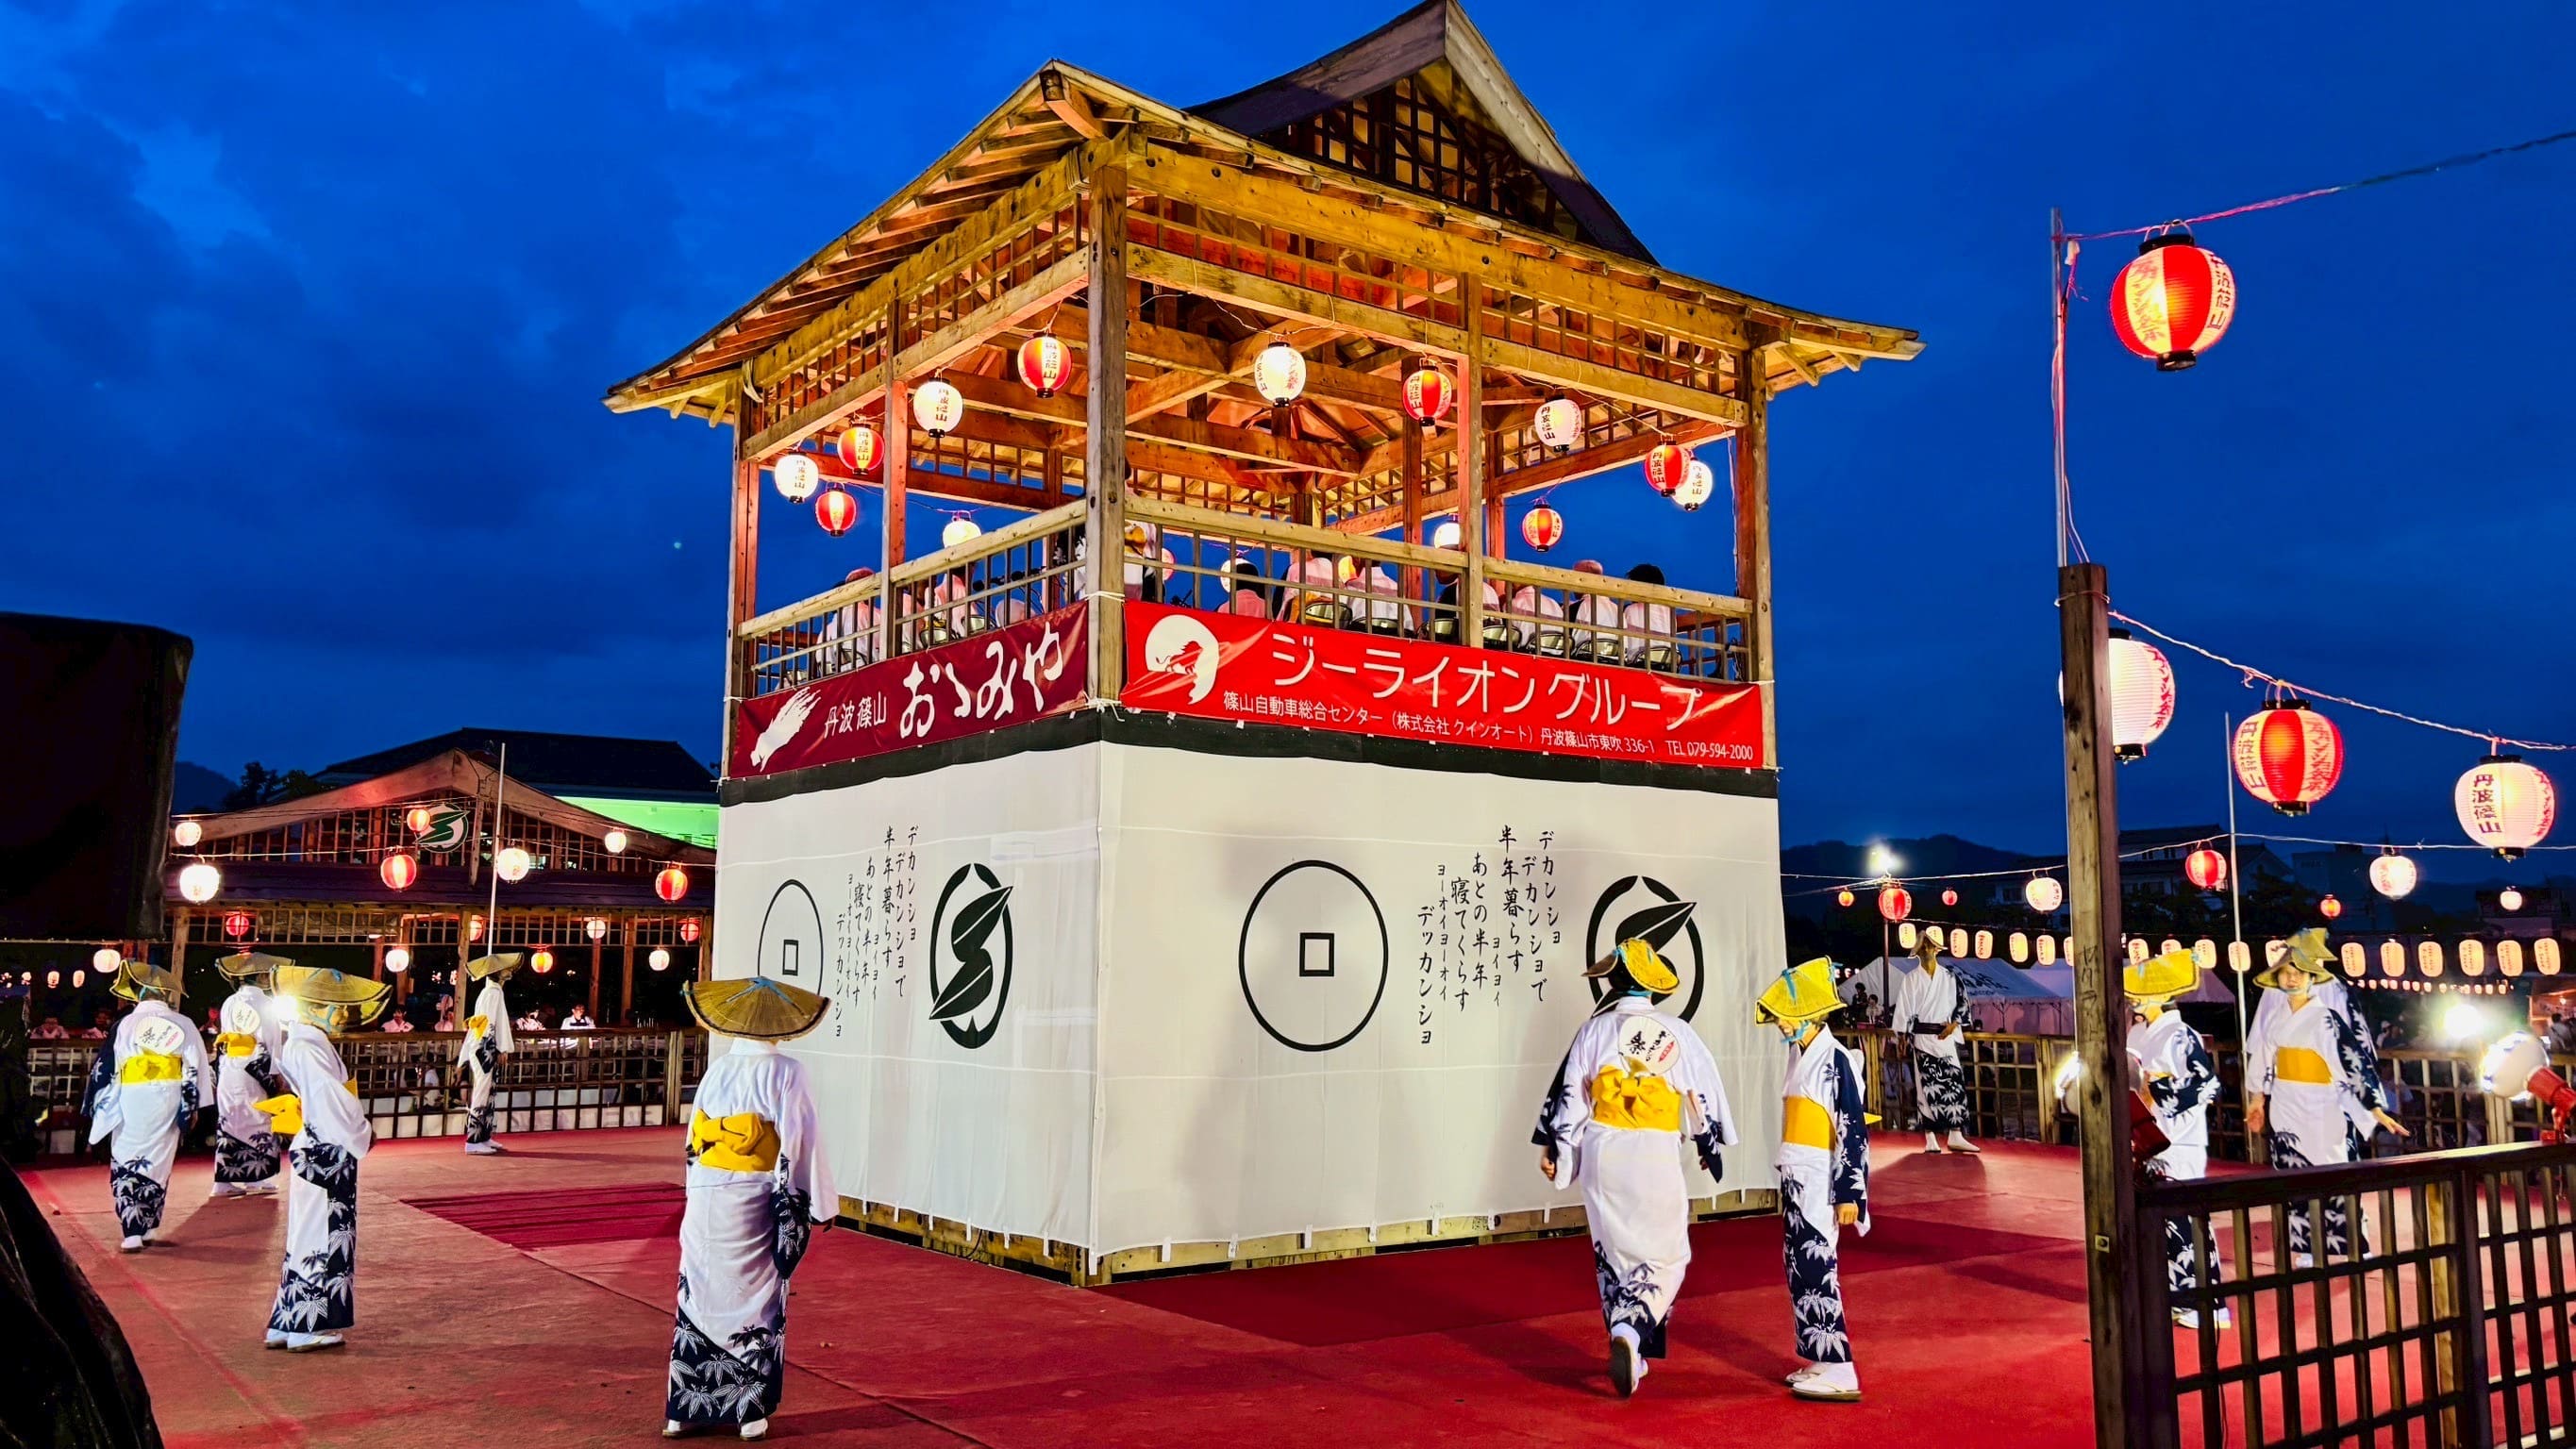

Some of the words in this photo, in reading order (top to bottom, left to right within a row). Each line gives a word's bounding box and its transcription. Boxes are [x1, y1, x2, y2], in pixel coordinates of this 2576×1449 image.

[823, 691, 888, 740] 丹波篠山
[1272, 633, 1704, 731] ジーライオングループ
[1665, 740, 1686, 757] TEL
[1686, 741, 1754, 760] 079-594-2000
[1450, 875, 1471, 1012] 寝てくらす
[1471, 851, 1490, 991] あとの半年
[1497, 824, 1525, 974] 半年暮らす
[1521, 855, 1548, 1003] デカンショで
[1538, 829, 1561, 945] デカンショ
[1416, 905, 1435, 1045] デッカンショ
